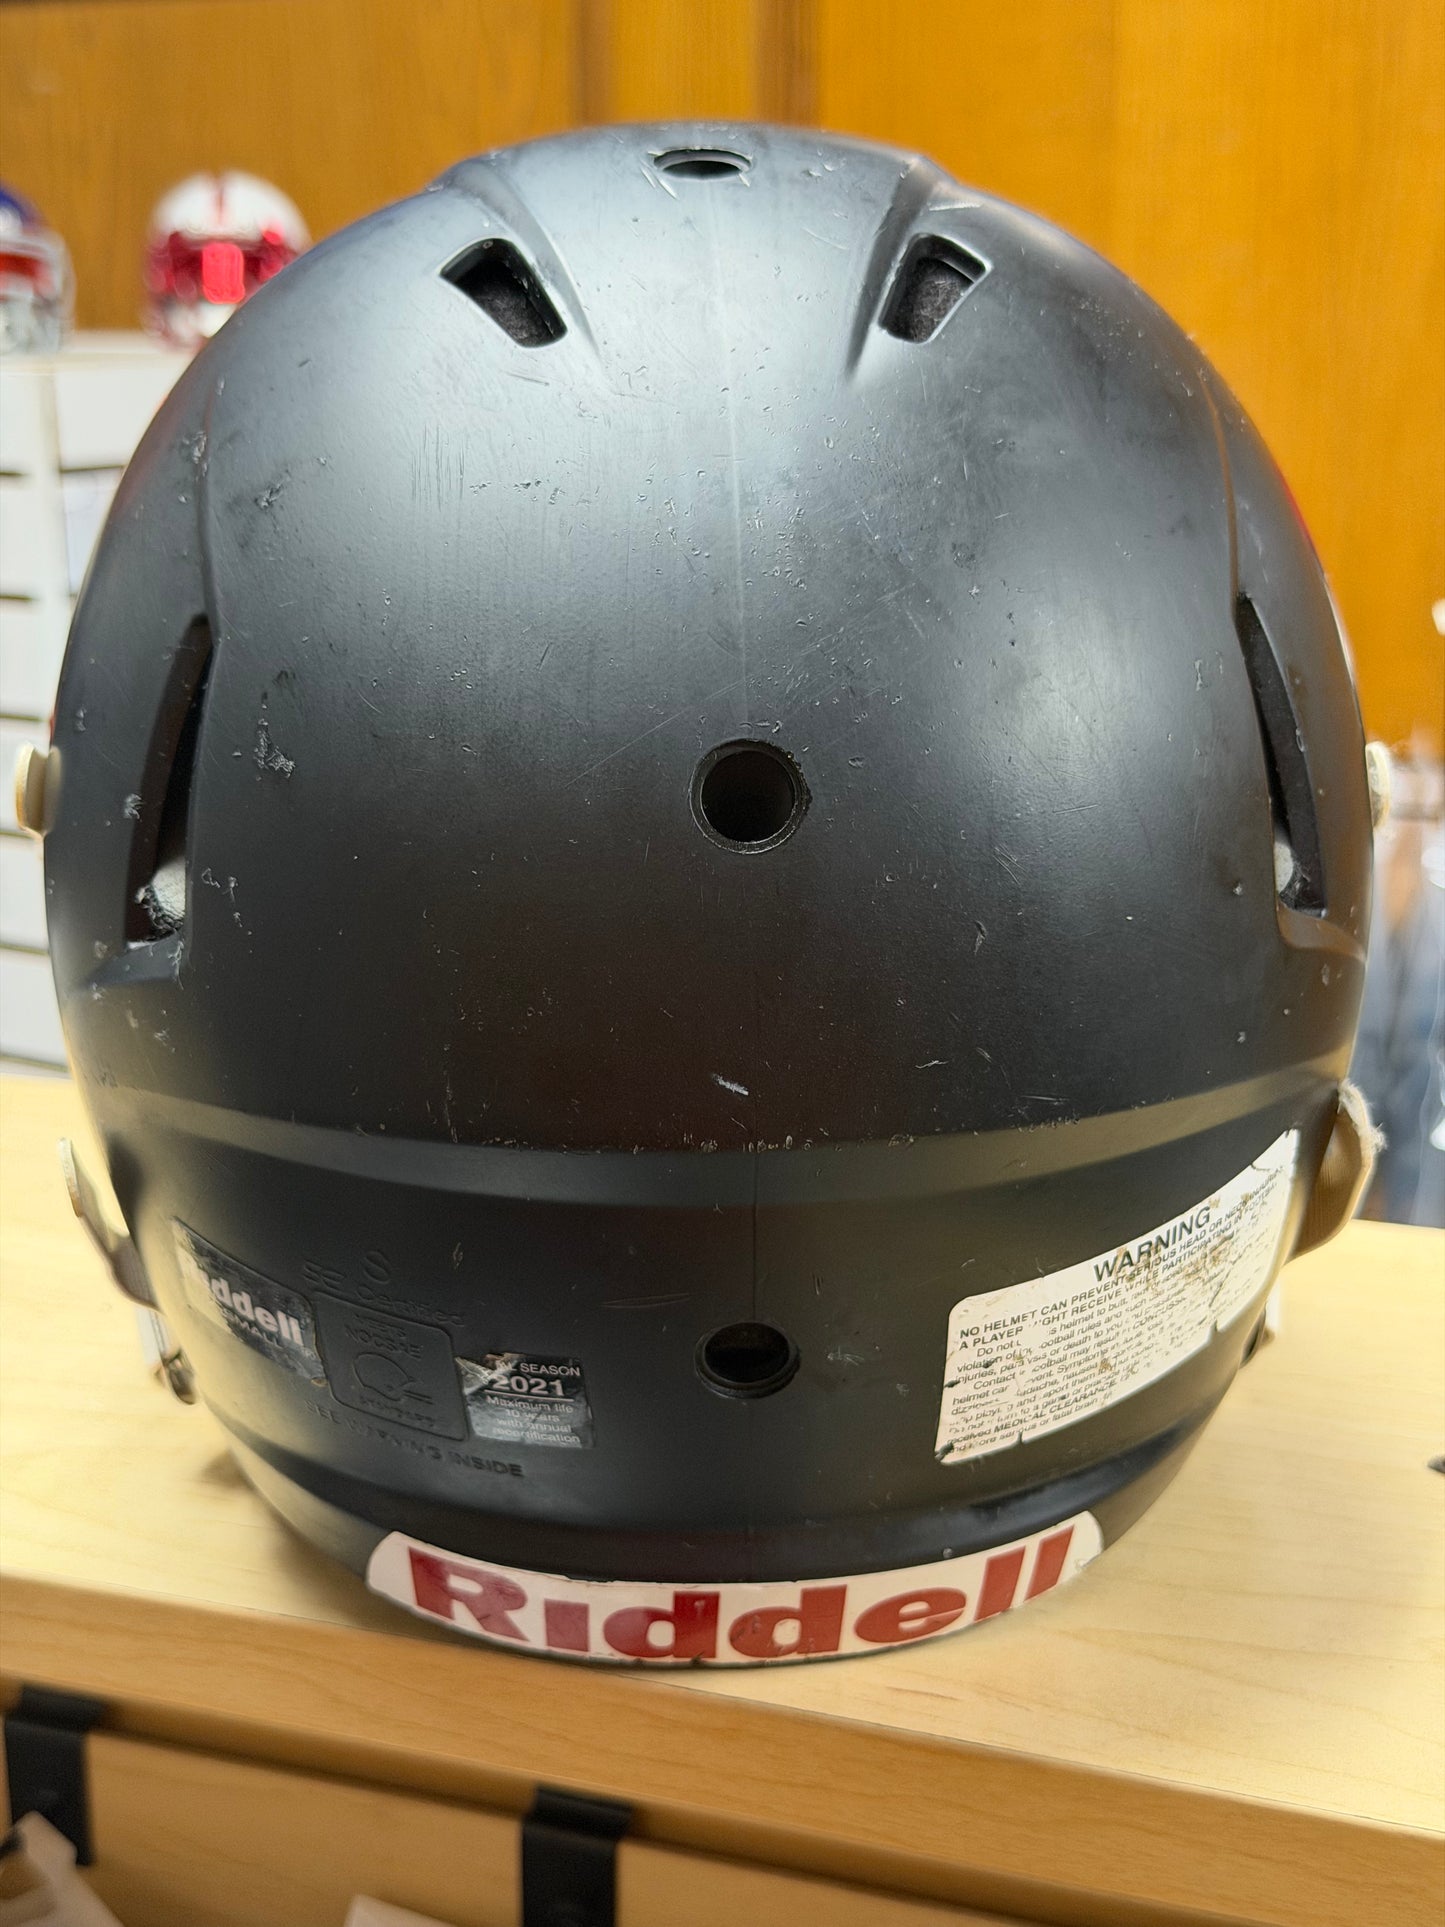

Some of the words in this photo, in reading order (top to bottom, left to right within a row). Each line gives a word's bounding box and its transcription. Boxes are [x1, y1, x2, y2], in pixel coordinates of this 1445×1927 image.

[1094, 1206, 1210, 1281] WARNING
[959, 1341, 968, 1351] A
[1071, 1289, 1122, 1317] RECEIVE
[1125, 1268, 1159, 1292] WHILE
[1162, 1221, 1232, 1274] PARTICIPATING
[960, 1326, 980, 1339] NO
[983, 1310, 1037, 1333] HELMET
[1041, 1299, 1068, 1316] CAN
[1071, 1275, 1126, 1305] PREVENT
[1126, 1248, 1177, 1280] SERIOUS
[1180, 1229, 1206, 1253] HEAD
[1209, 1217, 1222, 1233] OR
[976, 1347, 994, 1358] Do
[997, 1340, 1014, 1352] not
[1060, 1312, 1094, 1331] helmet
[1097, 1307, 1106, 1317] to
[1039, 1331, 1075, 1350] ootball
[1077, 1321, 1101, 1336] rules
[1104, 1311, 1122, 1324] and
[1050, 1346, 1061, 1356] or
[1063, 1335, 1091, 1351] death
[1094, 1330, 1104, 1339] to
[1106, 1320, 1123, 1335] you
[520, 1362, 580, 1377] SEASON
[974, 1372, 1016, 1390] Contact
[1070, 1345, 1091, 1360] may
[1094, 1330, 1120, 1348] result
[491, 1374, 565, 1397] 2021
[953, 1391, 990, 1406] helmet
[1017, 1395, 1036, 1408] and
[486, 1395, 551, 1412] Maximum
[554, 1402, 574, 1414] life
[504, 1408, 521, 1418] 10
[408, 1525, 1076, 1659] Riddell
